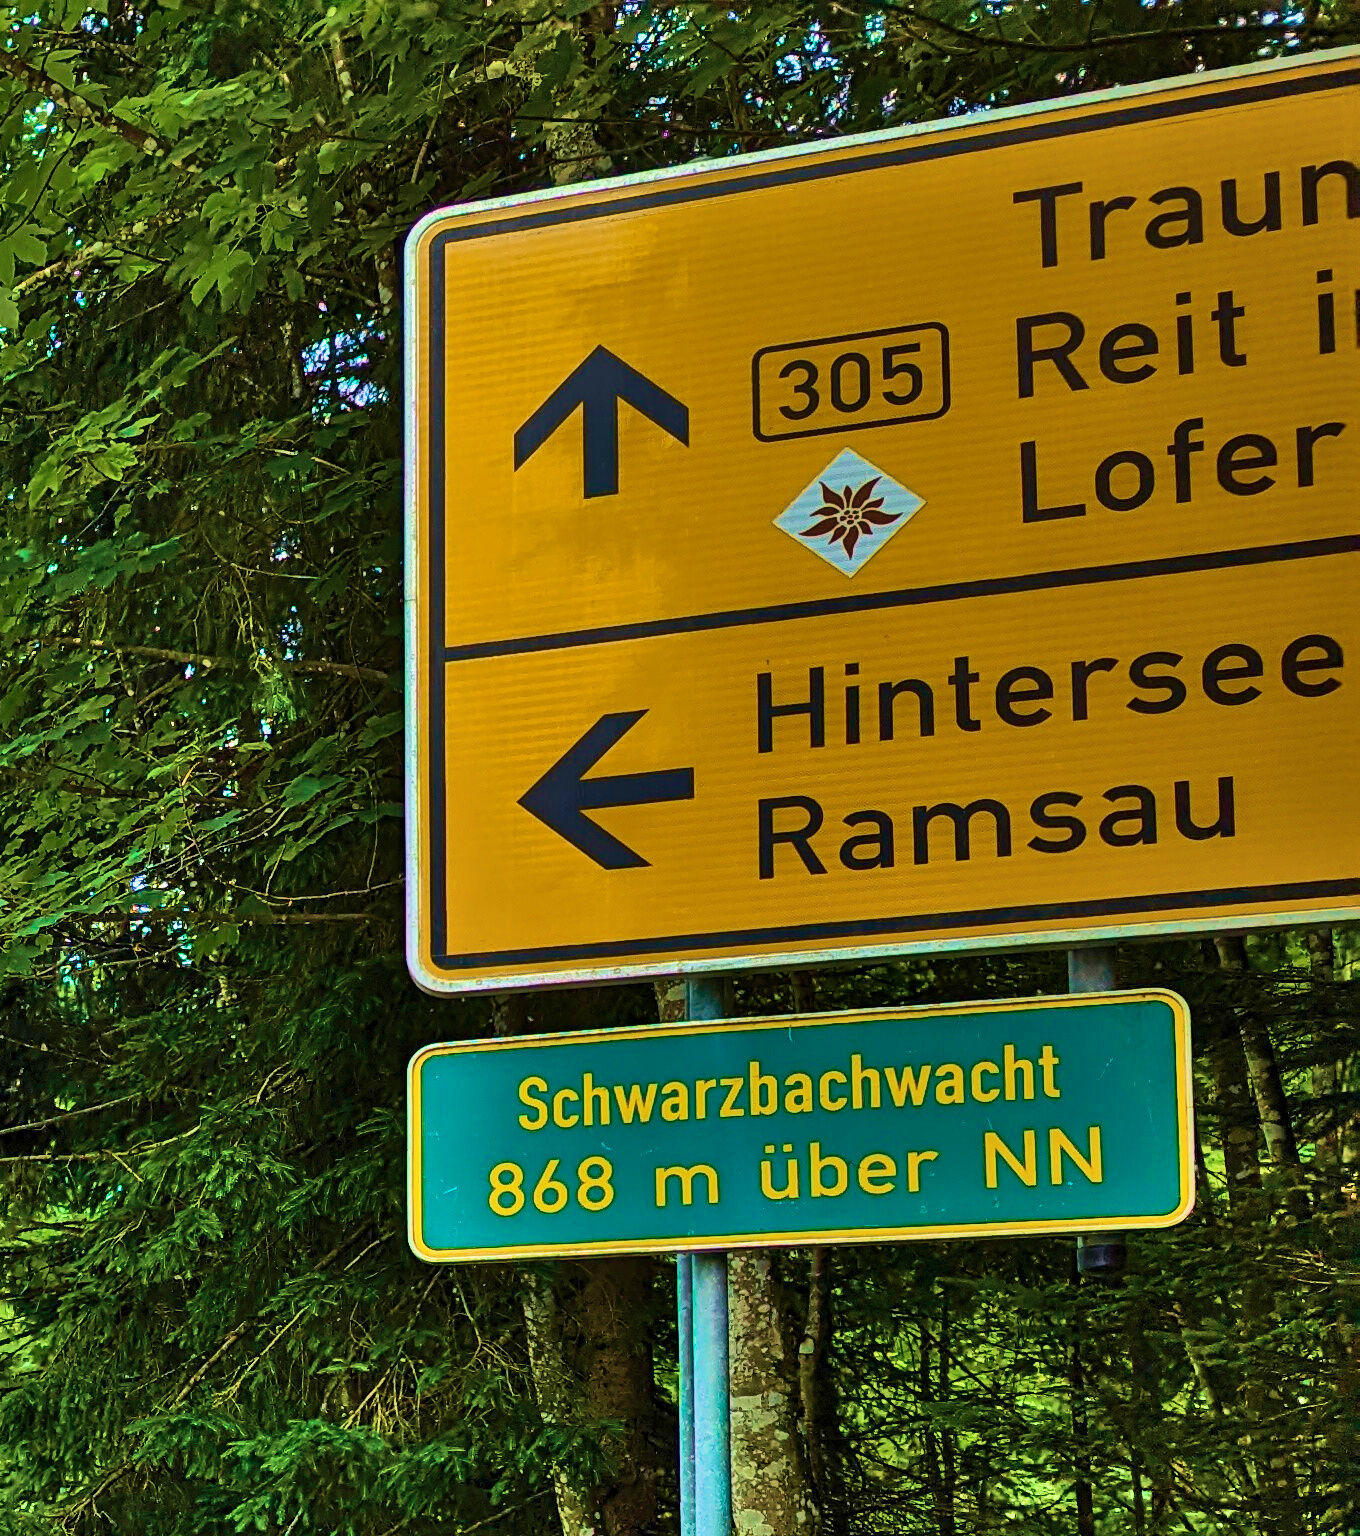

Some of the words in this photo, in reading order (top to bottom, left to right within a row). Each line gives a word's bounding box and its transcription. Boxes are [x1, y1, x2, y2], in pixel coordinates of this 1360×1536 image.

[778, 343, 925, 421] 305
[1017, 289, 1248, 400] Reit
[1316, 268, 1360, 356] i
[1020, 417, 1345, 524] Lofer
[756, 633, 1344, 754] Hintersee
[757, 775, 1237, 881] Ramsau
[517, 1044, 1062, 1132] Schwarzbachwacht
[488, 1155, 616, 1218] 868
[654, 1162, 720, 1207] m
[759, 1140, 940, 1202] über
[983, 1125, 1104, 1190] NN
